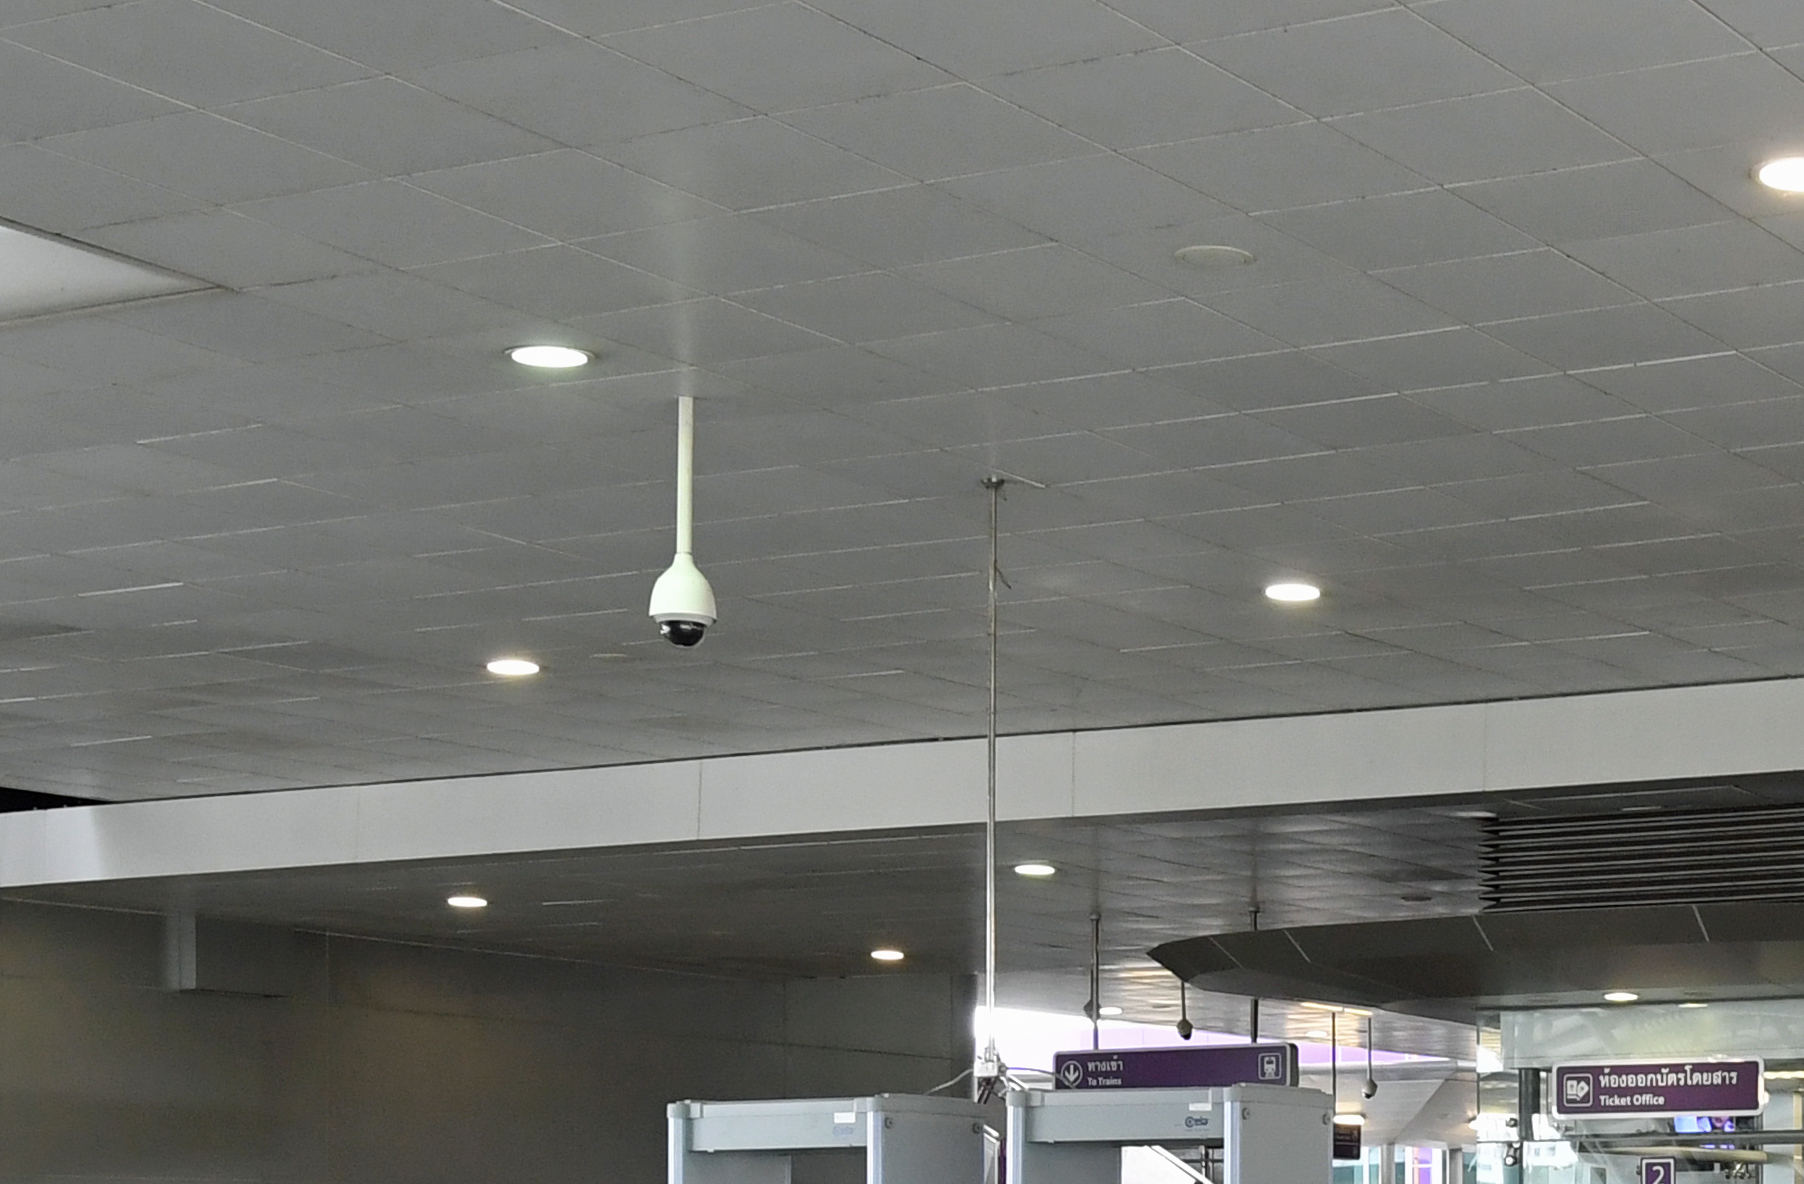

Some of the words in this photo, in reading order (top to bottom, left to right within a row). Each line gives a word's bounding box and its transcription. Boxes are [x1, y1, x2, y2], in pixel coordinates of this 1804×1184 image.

[1087, 1055, 1123, 1072] ทางเข้า
[1087, 1077, 1097, 1086] To
[1098, 1076, 1122, 1086] Trains
[1599, 1065, 1738, 1088] ห้องออกบัตรโดยสาร
[1599, 1094, 1632, 1106] Ticket
[1633, 1093, 1665, 1106] Office
